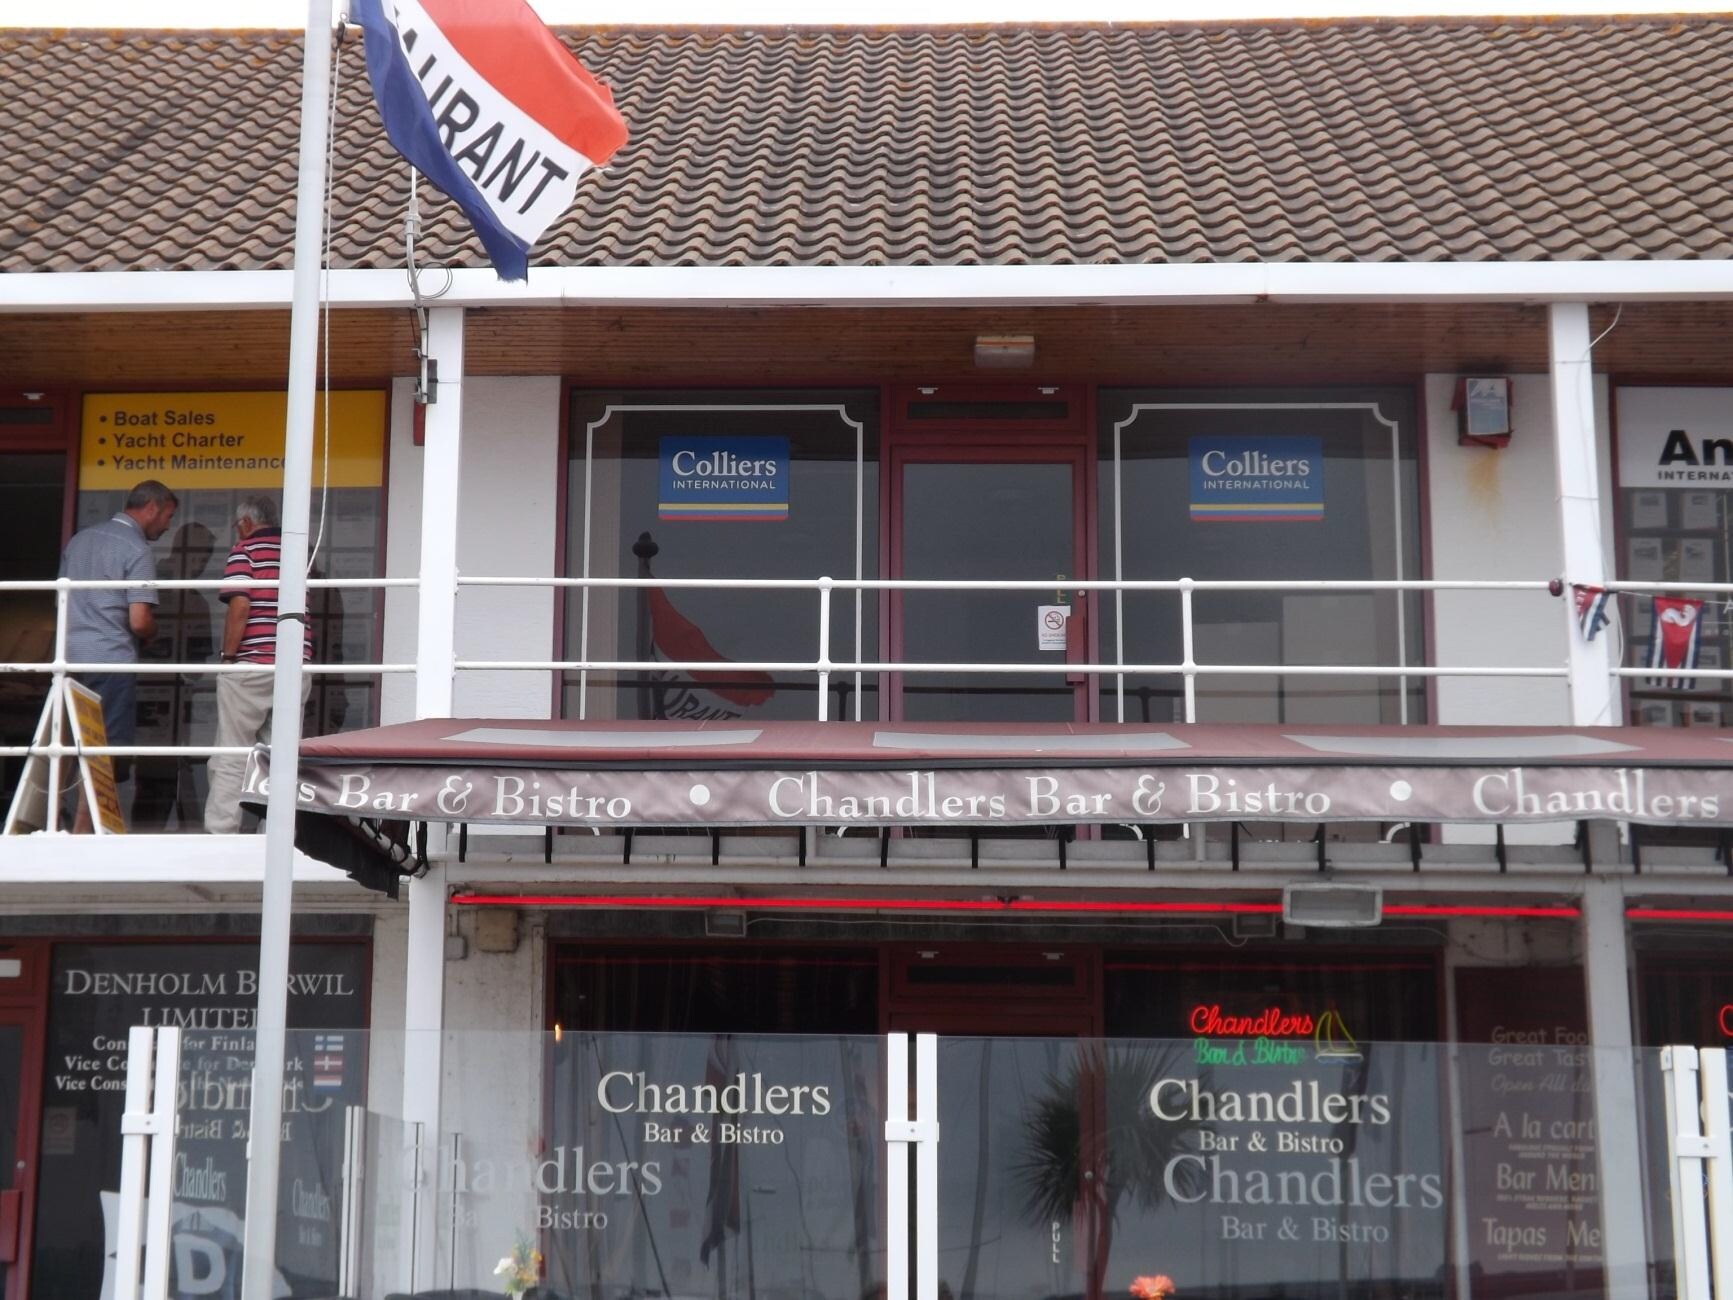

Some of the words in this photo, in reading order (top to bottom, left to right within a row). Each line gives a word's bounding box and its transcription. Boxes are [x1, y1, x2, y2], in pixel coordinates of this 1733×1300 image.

[114, 411, 158, 426] Boat
[164, 410, 215, 426] Sales
[113, 433, 165, 448] Yacht
[172, 432, 245, 448] Charter
[113, 455, 164, 470] Yacht
[672, 450, 777, 476] Colliers
[1201, 450, 1310, 476] Colliers
[673, 480, 776, 489] INTERNATIONAL
[1203, 480, 1310, 489] INTERNATIONAL
[1658, 471, 1733, 481] INTERNA
[335, 774, 420, 812] Bar
[437, 776, 473, 814] &
[492, 776, 632, 818] Bistro
[768, 771, 1007, 818] Chandlers
[1025, 776, 1112, 816] Bar
[1132, 774, 1166, 815] &
[1184, 774, 1332, 815] Bistro
[1472, 767, 1721, 818] Chandlers
[64, 970, 227, 995] DENHOLM
[236, 970, 354, 995] BRWIL
[1188, 1004, 1315, 1036] Chandlers
[211, 1036, 256, 1051] Finla
[1491, 1026, 1548, 1044] Great
[1555, 1026, 1590, 1044] Foo
[65, 1056, 100, 1071] Vice
[1488, 1047, 1545, 1066] Great
[55, 1075, 87, 1091] Vice
[597, 1071, 831, 1116] Chandlers
[1150, 1078, 1391, 1125] Chandlers
[643, 1123, 683, 1144] Bar
[691, 1123, 711, 1144] &
[719, 1123, 785, 1145] Bistro
[1493, 1111, 1513, 1138] A
[1521, 1112, 1542, 1139] la
[1550, 1120, 1598, 1139] cart
[1199, 1131, 1239, 1151] Bar
[1248, 1131, 1268, 1152] &
[1277, 1132, 1344, 1154] Bistro
[1163, 1153, 1444, 1209] Chandlers
[1497, 1162, 1537, 1190] Bar
[536, 1205, 609, 1230] Bistro
[1221, 1216, 1268, 1240] Bar
[1277, 1216, 1299, 1241] &
[1311, 1217, 1390, 1243] Bistro
[1052, 1222, 1061, 1263] PULL
[1482, 1218, 1547, 1253] Tapas
[1566, 1220, 1602, 1247] Me
